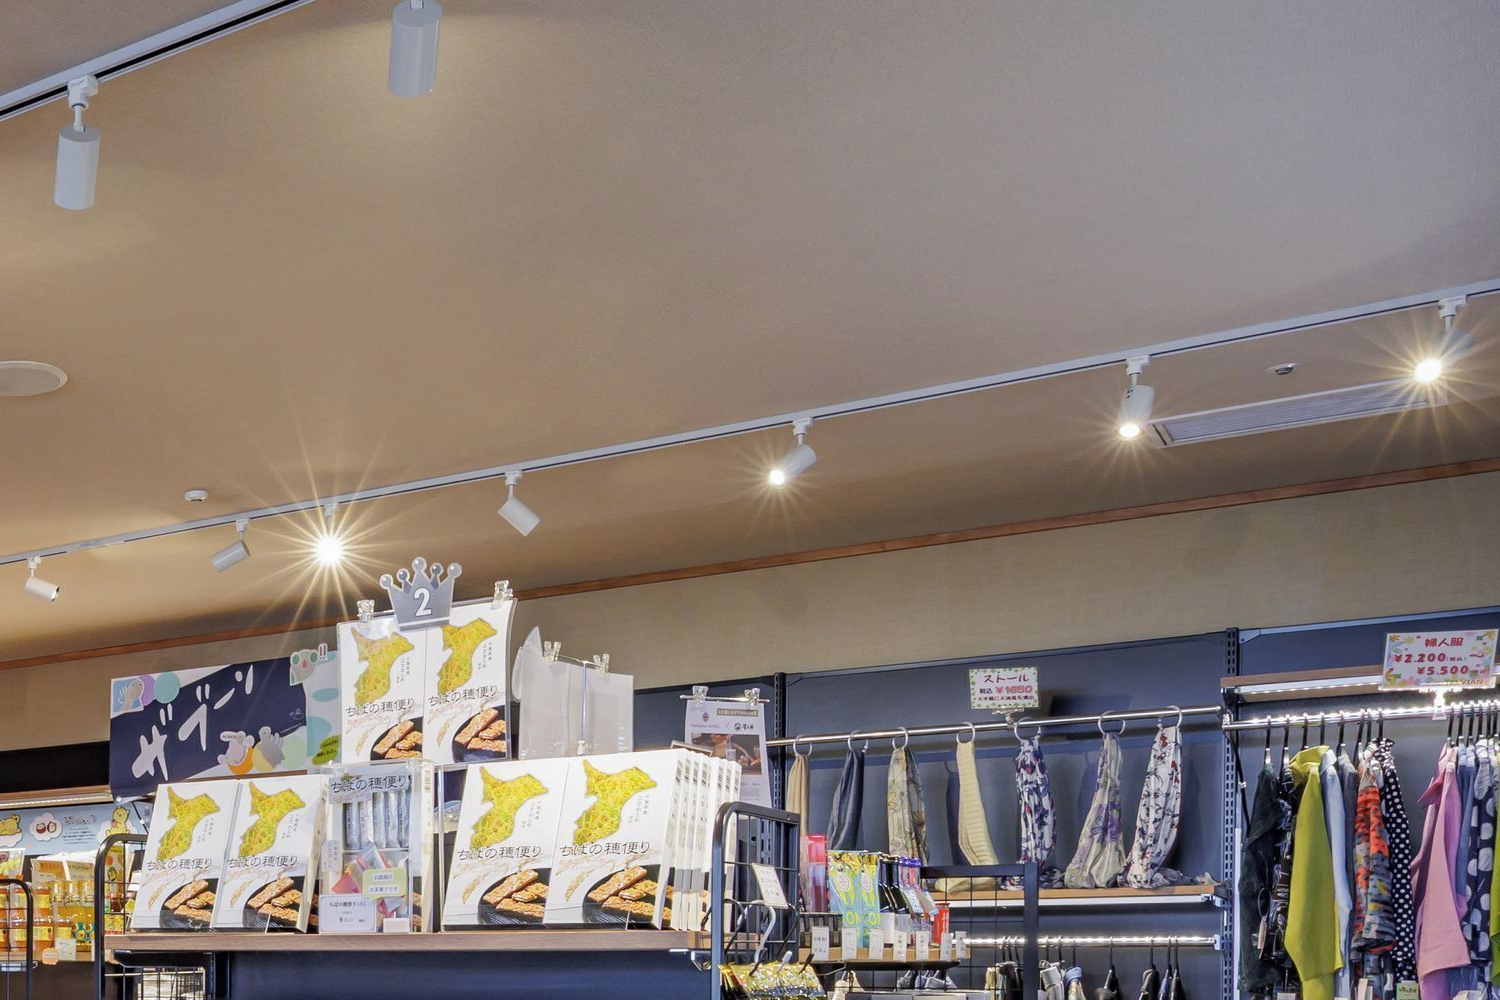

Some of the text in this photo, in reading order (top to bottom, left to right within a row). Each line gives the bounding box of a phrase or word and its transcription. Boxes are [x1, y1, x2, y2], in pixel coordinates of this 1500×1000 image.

[414, 588, 432, 617] 2
[1424, 637, 1464, 648] 婦人服
[984, 671, 1030, 683] ストール
[428, 684, 498, 706] ちばの穂便り
[345, 697, 415, 717] ちばの穂便り
[331, 776, 407, 793] ちばの穂便り
[457, 844, 542, 861] ちばの穂便り
[559, 841, 651, 857] ちばの穂便り
[146, 857, 213, 872] ちばの穂便り
[228, 854, 298, 868] ちばの穂便り
